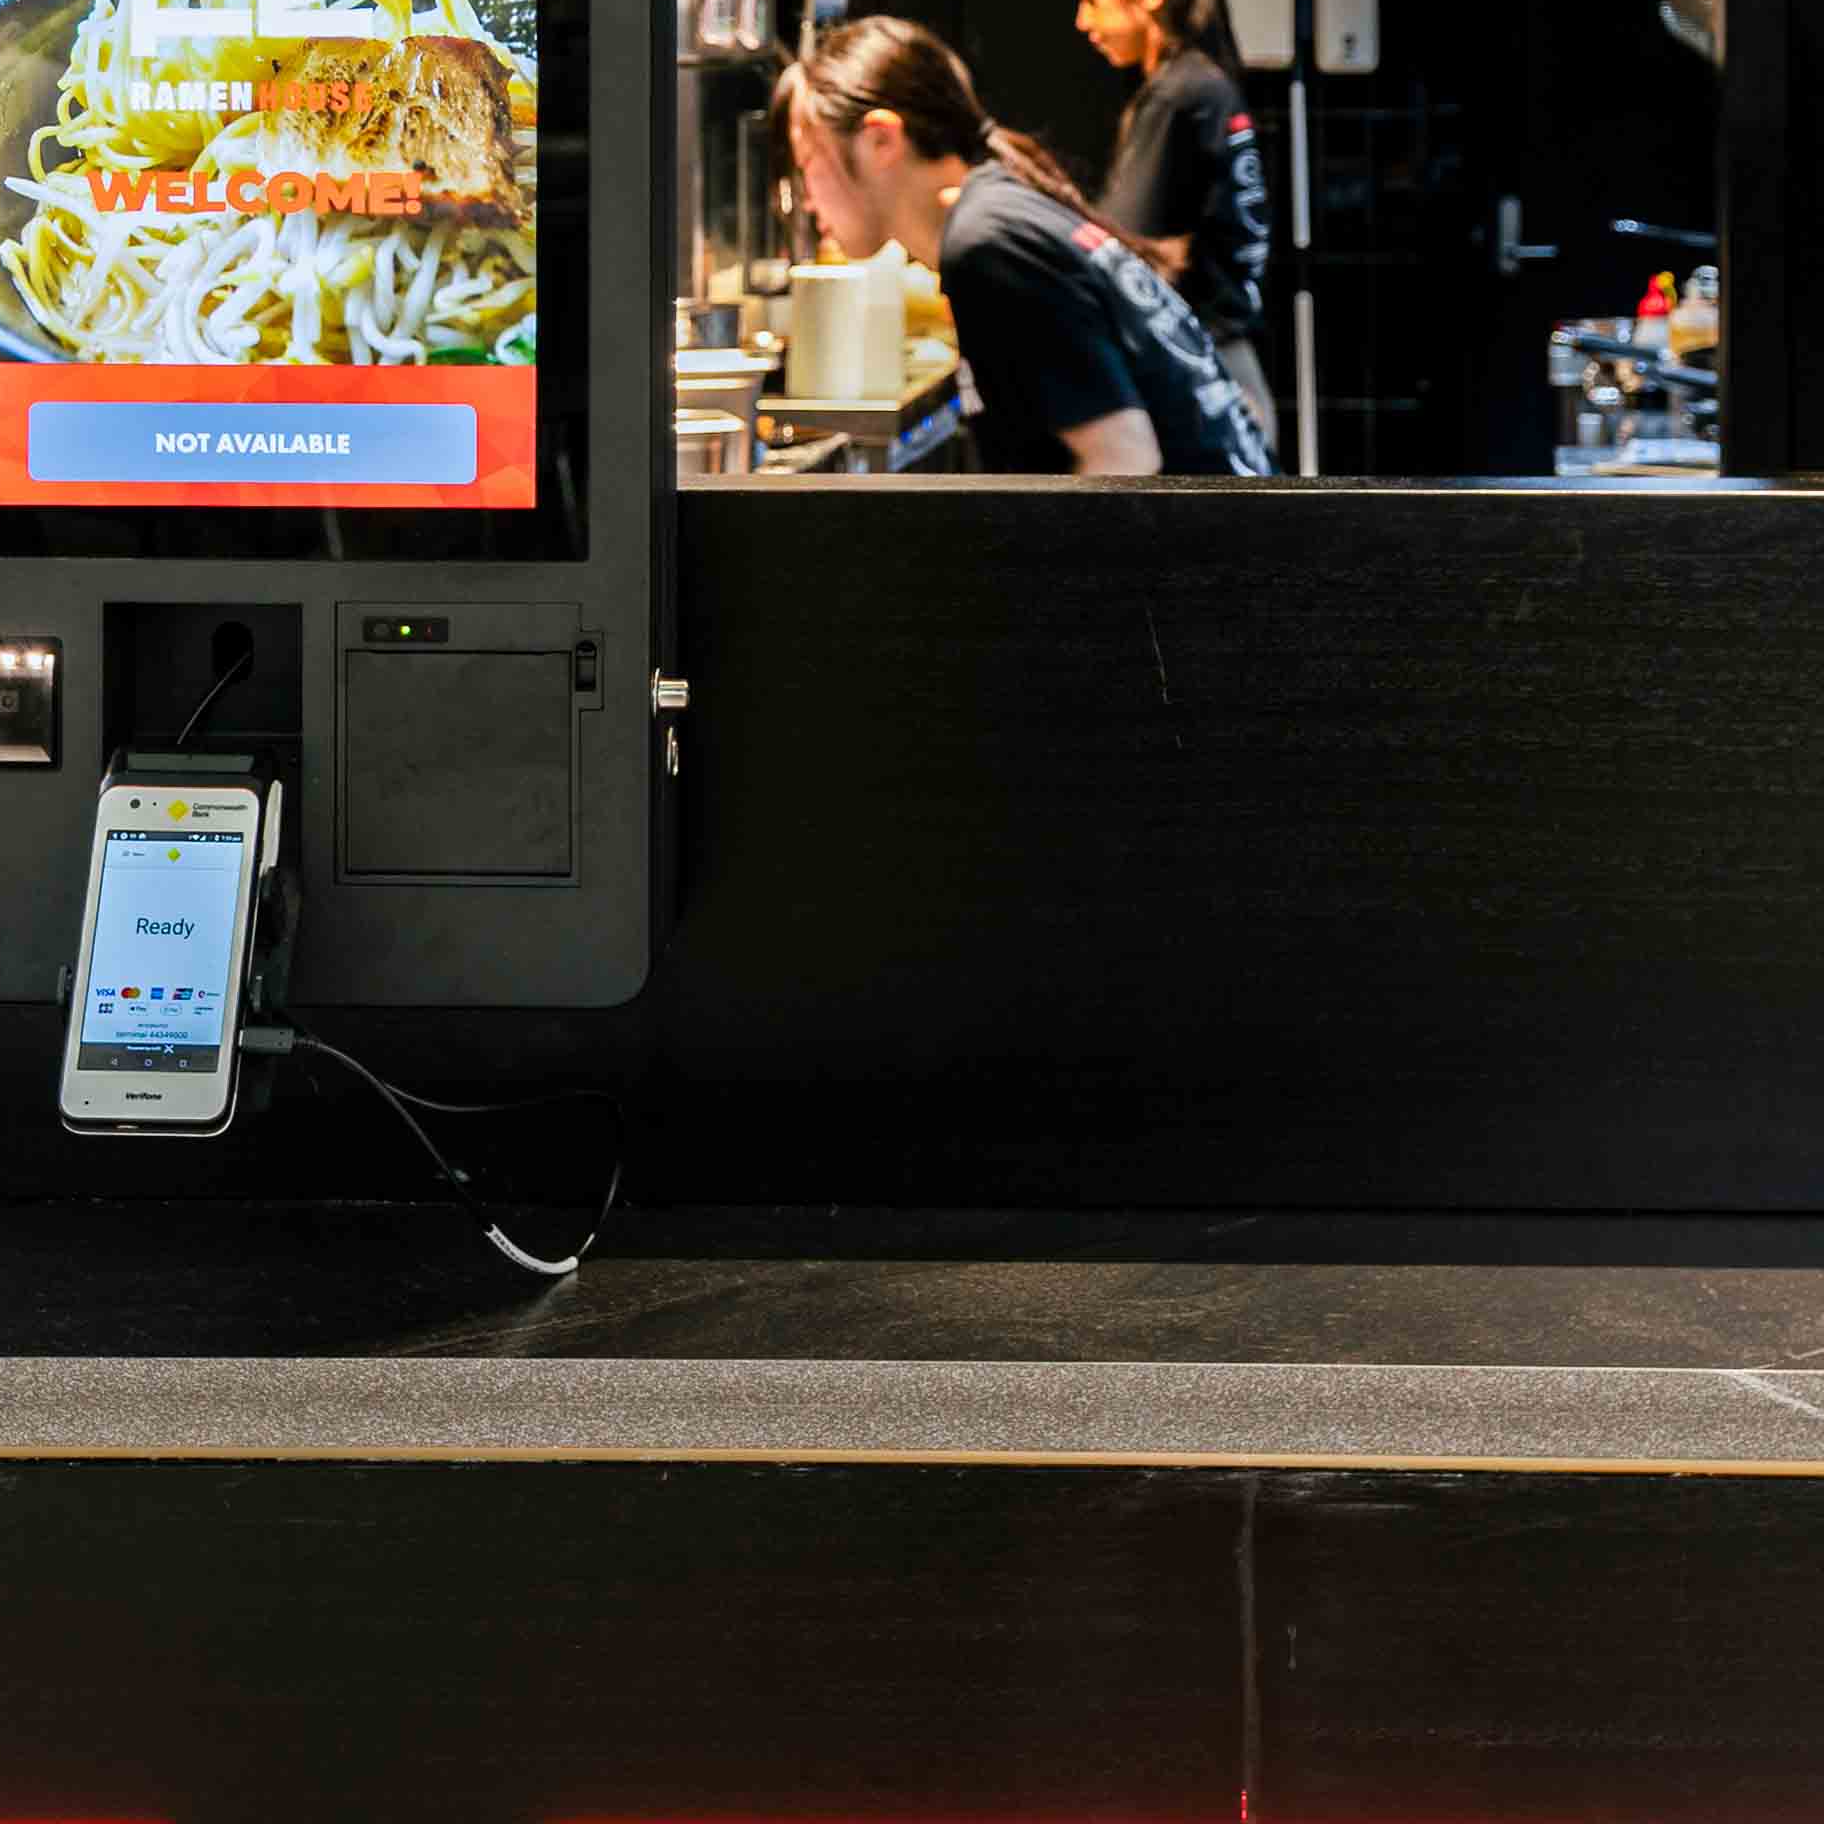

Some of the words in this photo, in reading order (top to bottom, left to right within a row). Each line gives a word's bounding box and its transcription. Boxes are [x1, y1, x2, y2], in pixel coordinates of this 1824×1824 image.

[129, 80, 253, 112] RAMEN
[86, 170, 424, 216] WELCOME!
[155, 432, 210, 455] NOT
[216, 432, 351, 455] AVAILABLE
[136, 918, 195, 940] Ready
[95, 987, 116, 998] VISA
